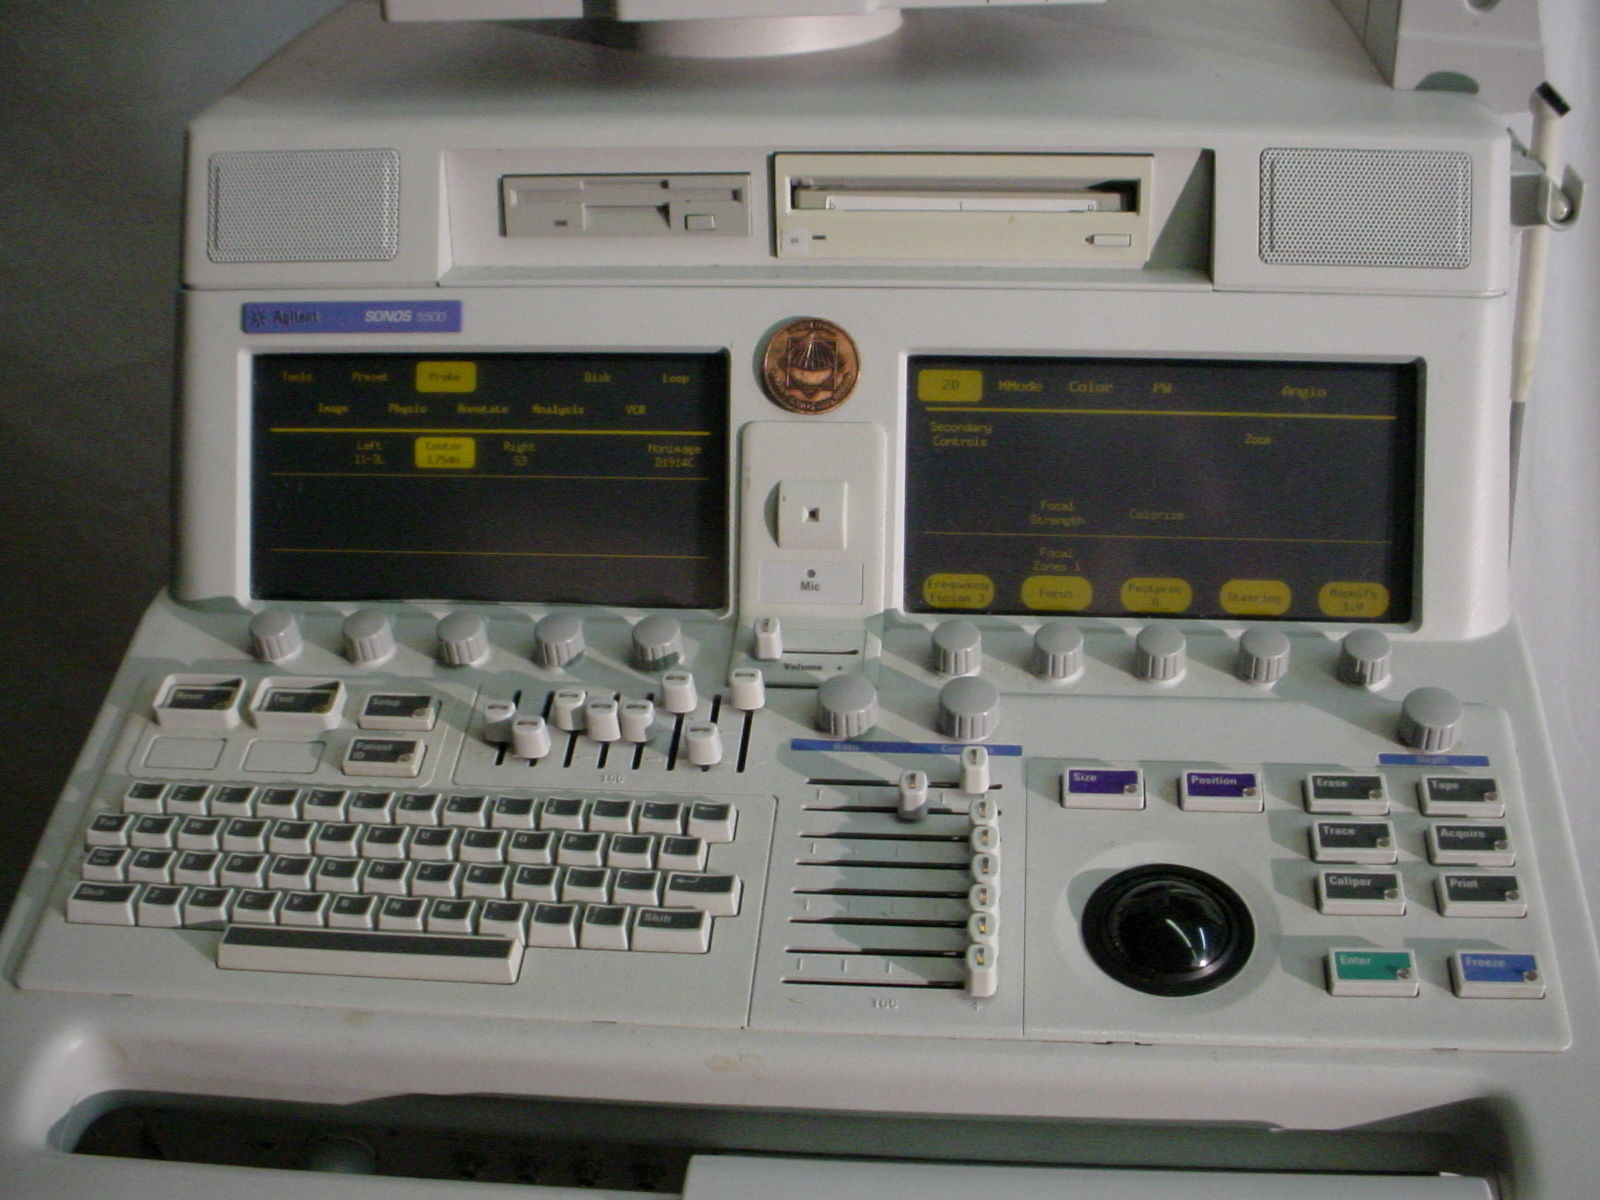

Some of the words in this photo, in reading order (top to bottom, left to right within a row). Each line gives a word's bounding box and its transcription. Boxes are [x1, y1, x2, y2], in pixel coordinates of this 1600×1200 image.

[273, 310, 320, 325] Agilent
[365, 310, 412, 322] SONOS
[416, 311, 447, 323] 5500
[428, 371, 463, 383] Probe
[941, 378, 960, 391] 2D
[998, 380, 1044, 393] MMode
[1068, 380, 1114, 393] Color
[1280, 385, 1327, 398] Angio
[929, 420, 993, 434] Secondary
[932, 435, 989, 448] Controls
[800, 581, 821, 592] Mic
[783, 662, 823, 671] Volume
[355, 742, 394, 752] Patient
[352, 751, 363, 760] ID
[1073, 771, 1098, 782] Size
[1191, 775, 1238, 786] Position
[1316, 777, 1349, 788] Erase
[1432, 780, 1460, 791] Tape
[1323, 825, 1356, 836] Trace
[1440, 828, 1486, 840] Acquire
[1329, 875, 1373, 887] Caliper
[1450, 878, 1479, 888] Print
[1340, 955, 1372, 966] Enter
[1465, 957, 1506, 968] Freeze
